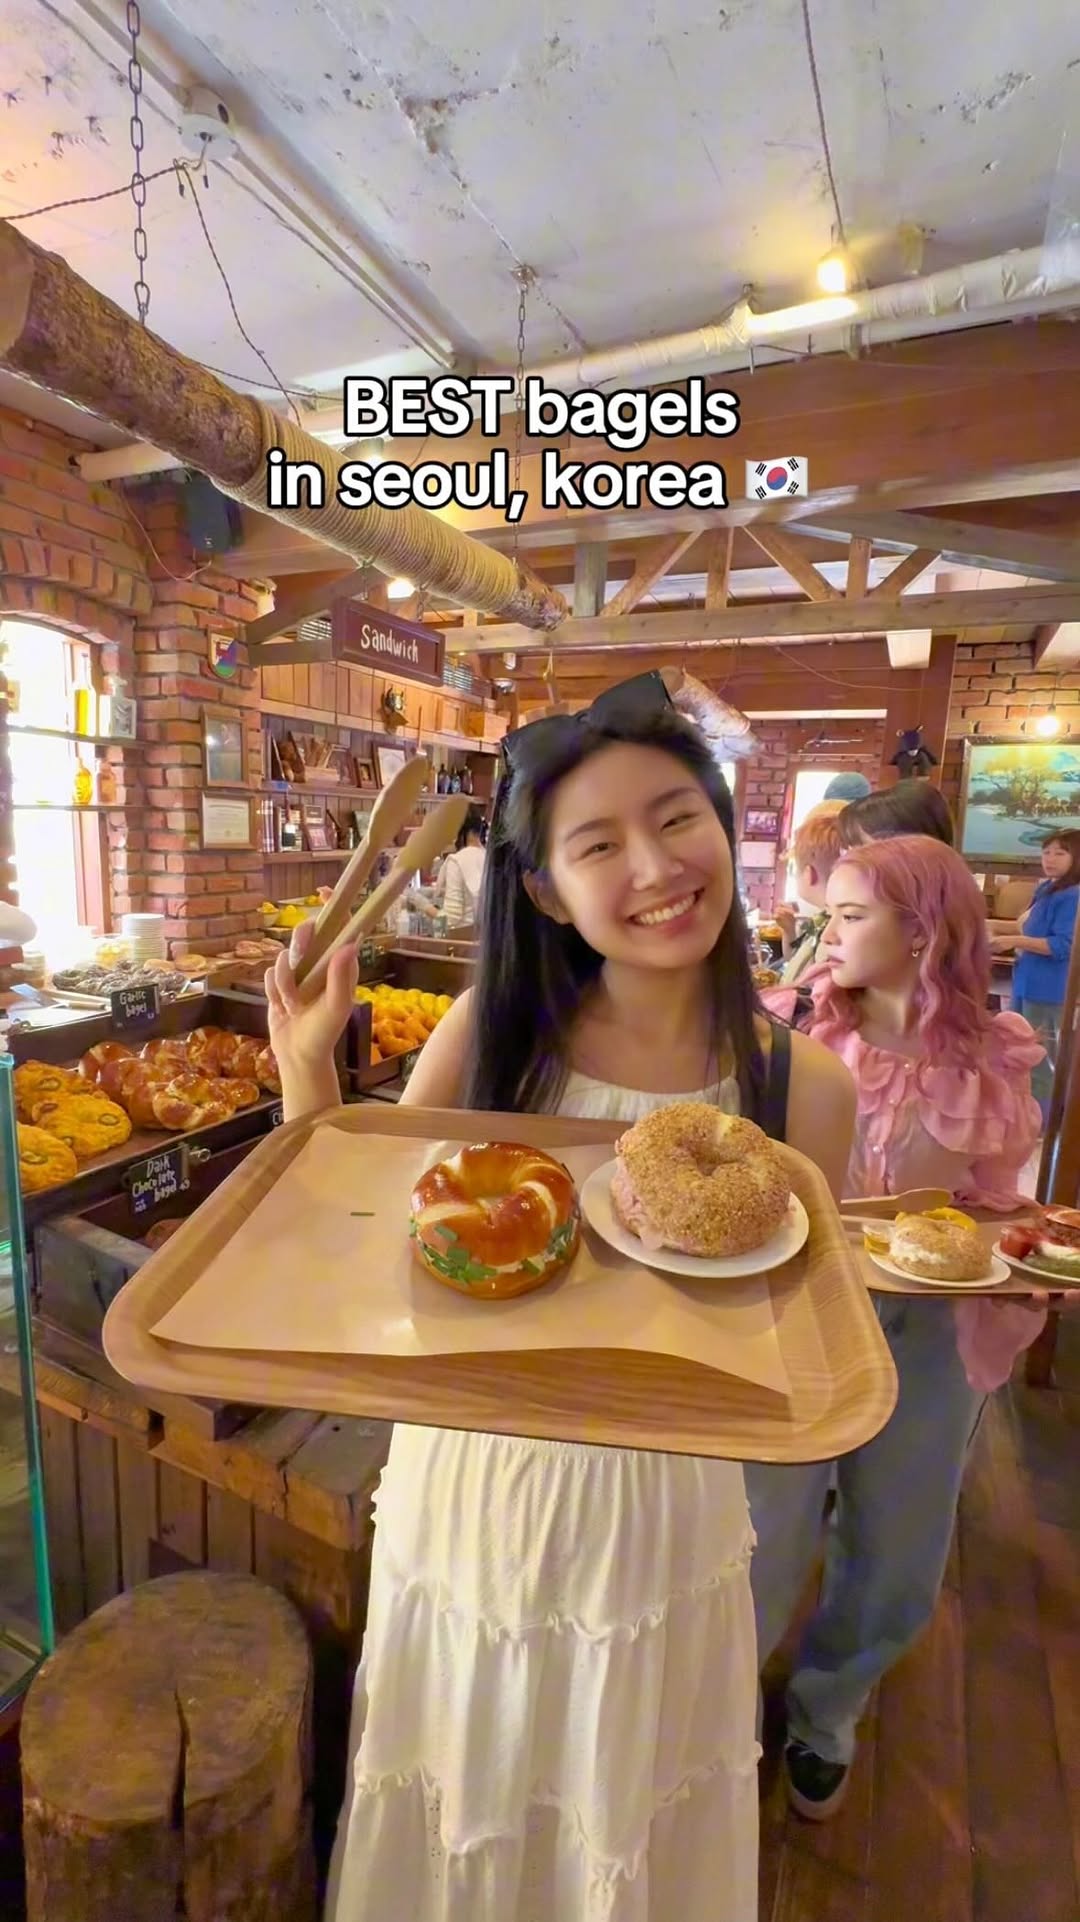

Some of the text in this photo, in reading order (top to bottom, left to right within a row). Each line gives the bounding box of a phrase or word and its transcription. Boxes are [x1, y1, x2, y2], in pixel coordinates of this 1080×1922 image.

[360, 623, 419, 664] Sandwich
[120, 991, 147, 1005] Garlic
[125, 1002, 147, 1018] bagel
[146, 1155, 171, 1179] Dark
[154, 1183, 177, 1202] bagel
